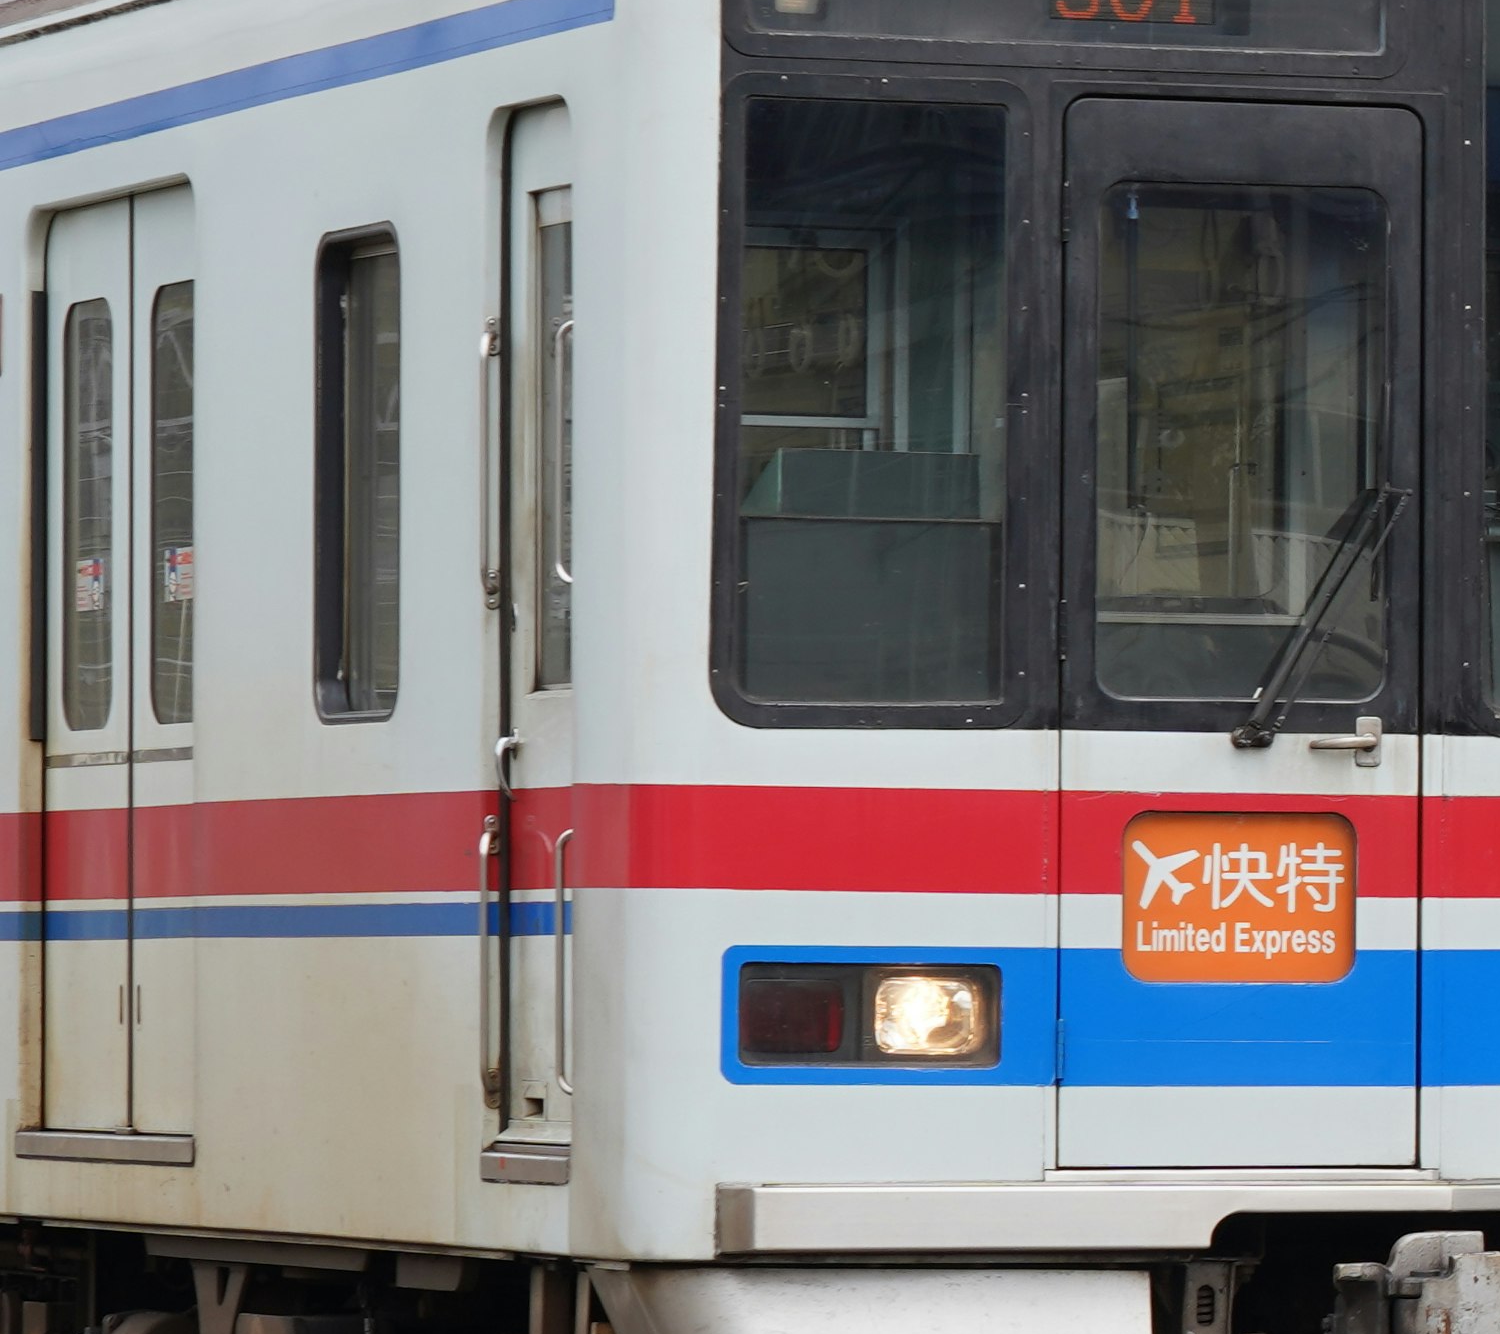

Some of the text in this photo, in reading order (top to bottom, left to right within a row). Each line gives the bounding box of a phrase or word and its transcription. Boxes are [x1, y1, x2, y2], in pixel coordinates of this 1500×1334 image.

[1202, 842, 1344, 913] 快特
[1136, 921, 1336, 960] Limited Express
